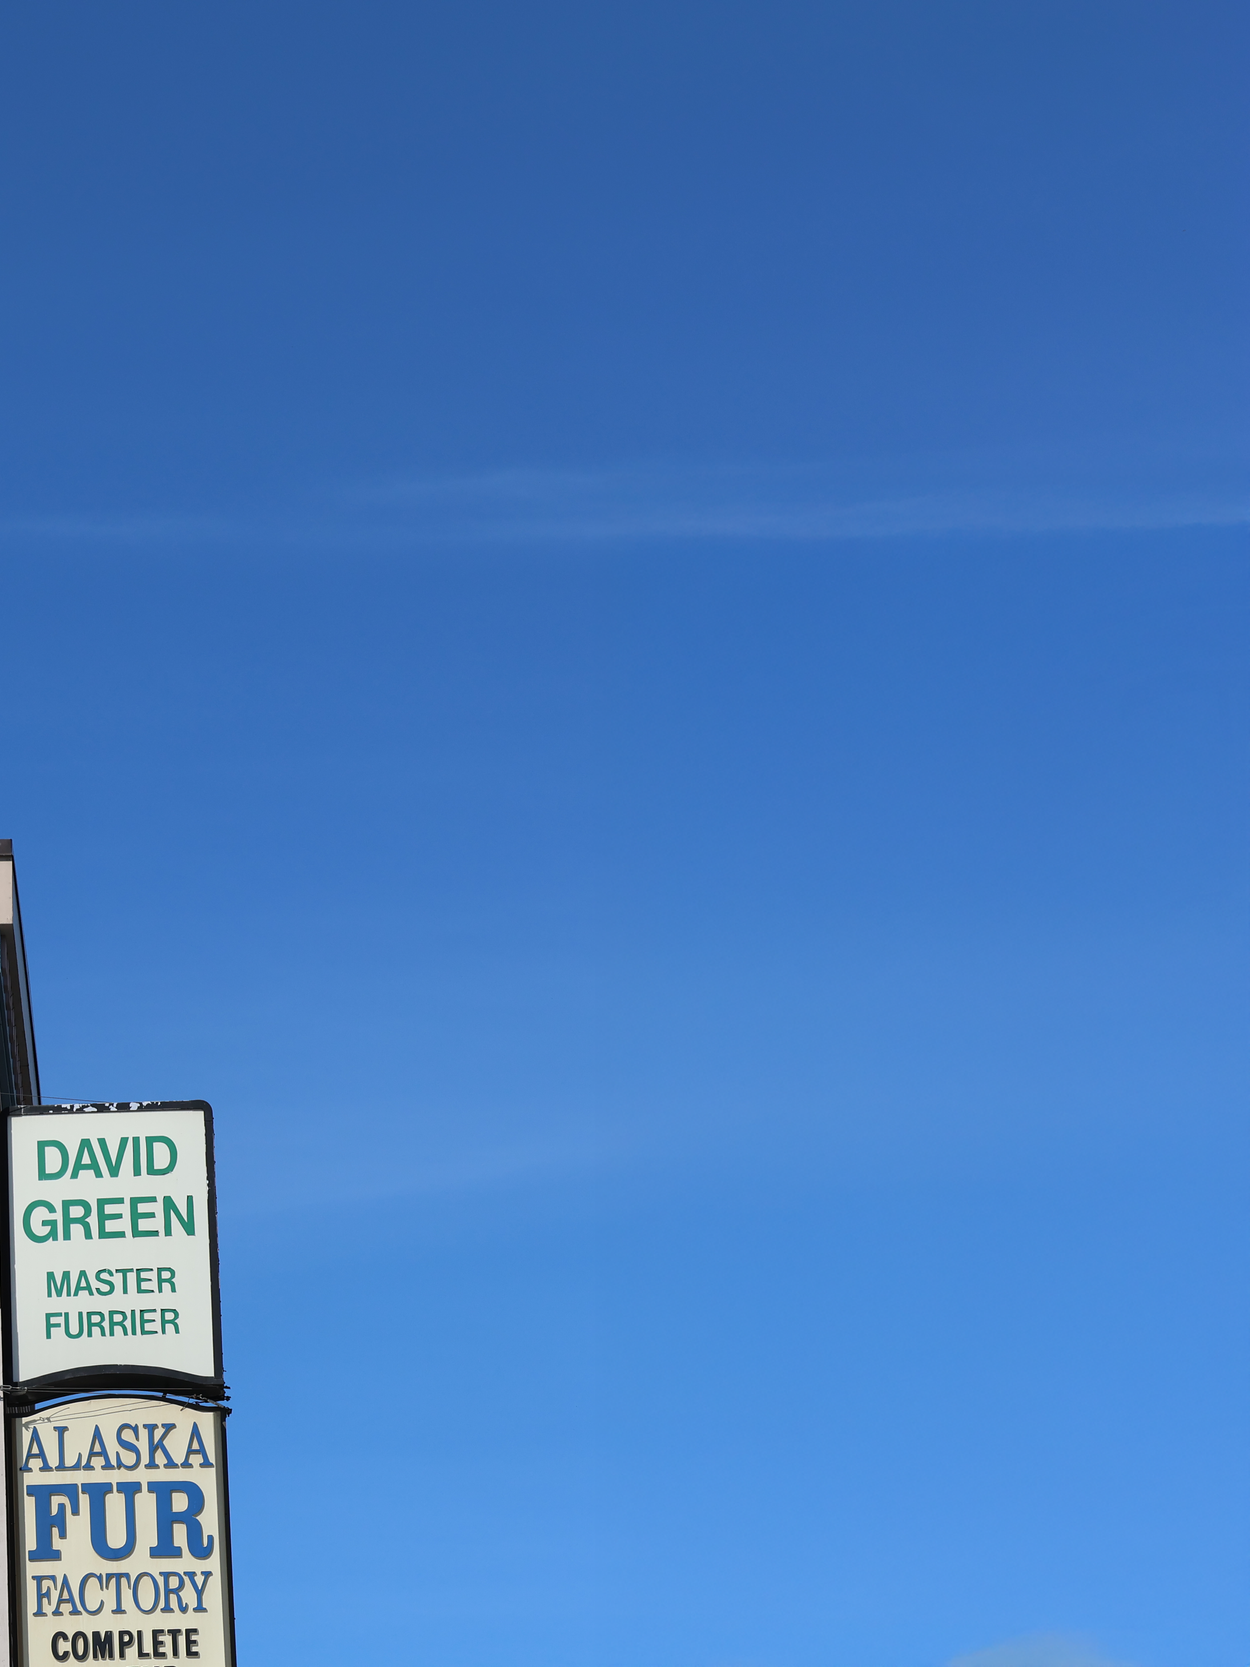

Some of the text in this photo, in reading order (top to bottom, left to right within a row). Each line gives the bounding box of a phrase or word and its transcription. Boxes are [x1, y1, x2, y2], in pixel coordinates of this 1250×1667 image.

[37, 1135, 178, 1181] DAVID
[22, 1195, 196, 1243] GREEN
[46, 1267, 177, 1298] MASTER
[45, 1308, 181, 1339] FURRIER
[20, 1421, 215, 1472] ALASKA
[26, 1480, 215, 1562] FUR
[31, 1571, 213, 1617] FACTORY
[51, 1628, 200, 1661] COMPLETE
